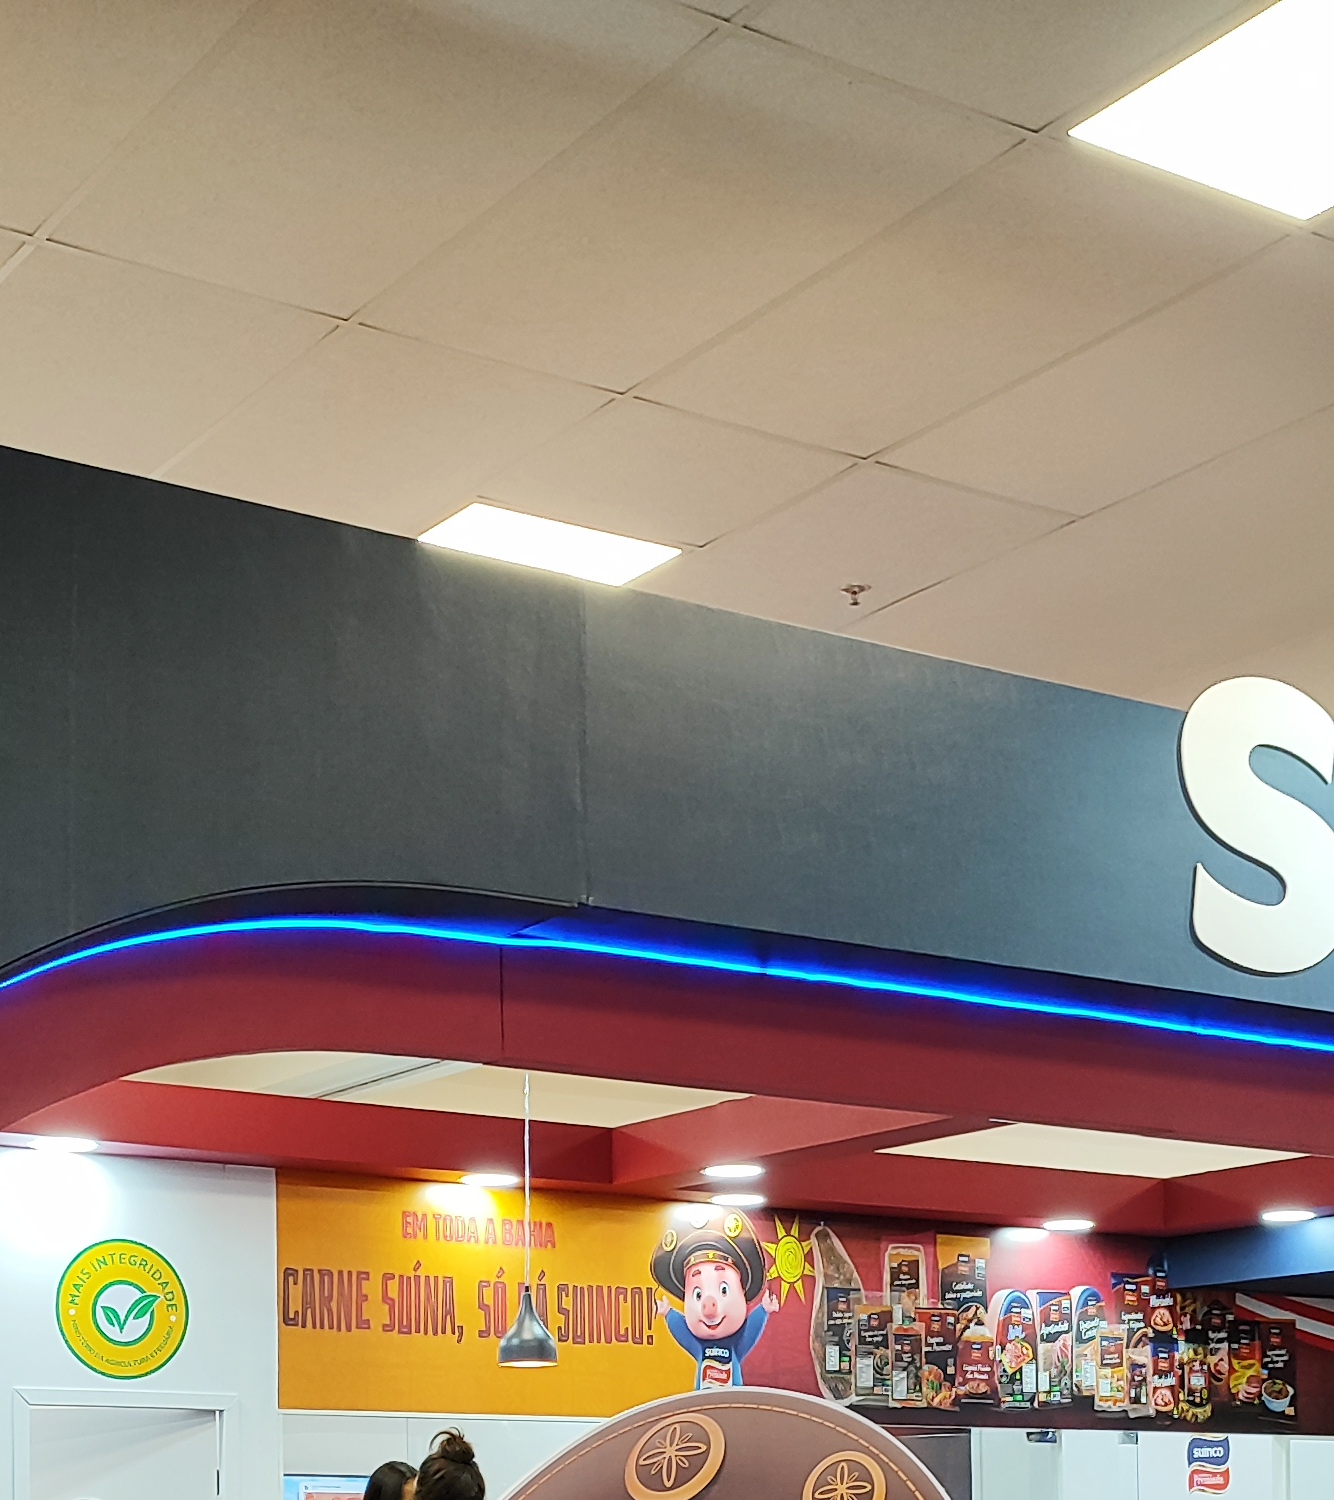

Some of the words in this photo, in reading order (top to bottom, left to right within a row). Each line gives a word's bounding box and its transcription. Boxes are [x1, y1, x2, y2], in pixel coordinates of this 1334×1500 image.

[402, 1211, 427, 1240] EM
[433, 1213, 478, 1244] TODA
[485, 1218, 497, 1245] A
[502, 1218, 556, 1249] BAHIA
[68, 1267, 92, 1306] MAIS
[89, 1252, 178, 1313] INTEGRIDADE
[282, 1267, 371, 1333] CARNE
[381, 1260, 464, 1344] SUÍNA,
[478, 1267, 507, 1338] SÓ
[557, 1283, 654, 1345] SUINCO!
